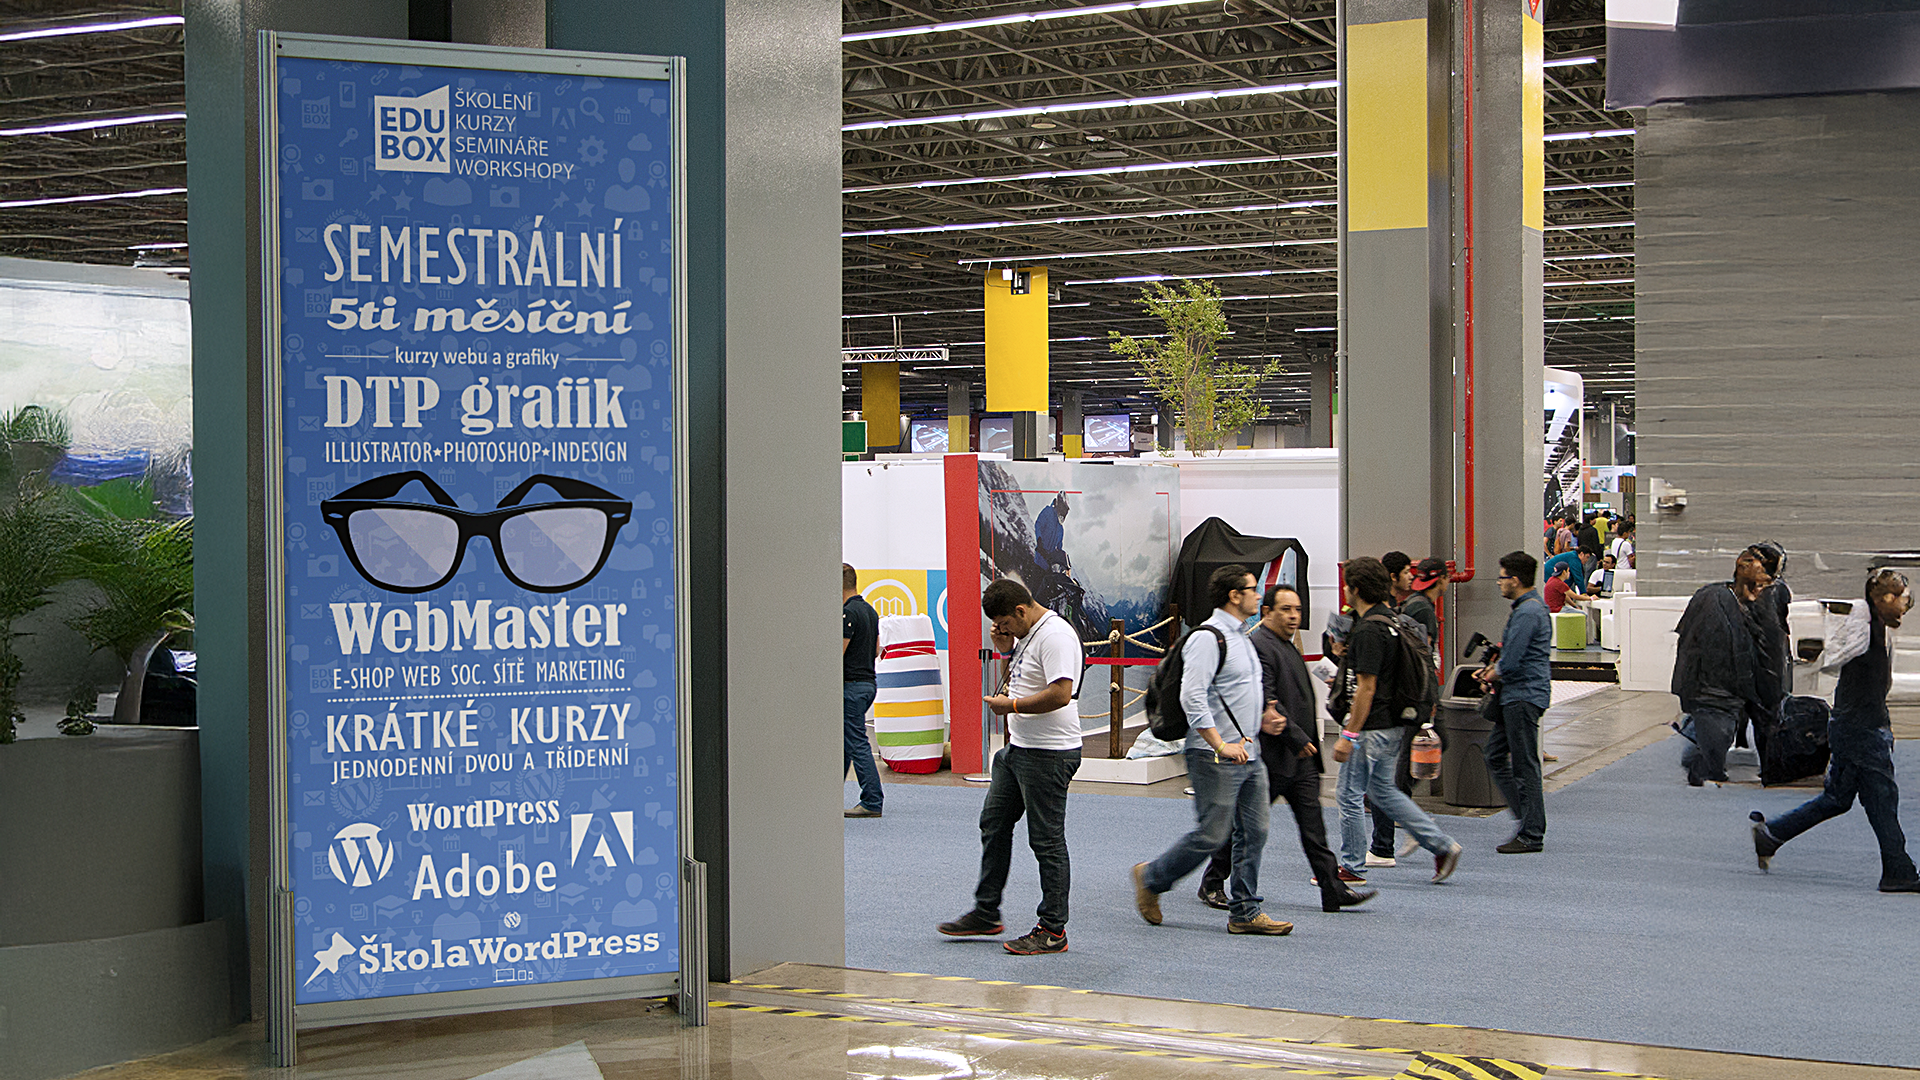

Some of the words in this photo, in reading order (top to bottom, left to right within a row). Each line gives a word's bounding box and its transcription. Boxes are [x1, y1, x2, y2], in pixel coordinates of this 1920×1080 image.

[304, 103, 329, 114] EDU
[455, 89, 532, 111] ŠKOLENÍ
[304, 113, 329, 125] BOX
[380, 106, 446, 134] EDU
[455, 113, 516, 132] KURZY
[380, 135, 447, 163] BOX
[455, 136, 549, 157] SEMINÁŘE
[455, 158, 574, 180] WORKSHOPY
[323, 215, 623, 288] SEMESTRÁLNÍ
[327, 296, 401, 331] 5ti
[413, 298, 632, 335] měsíční
[395, 346, 439, 368] kurzy
[442, 347, 488, 365] webu
[492, 352, 501, 365] a
[506, 348, 560, 370] grafiky
[323, 375, 440, 428] DTP
[460, 376, 628, 436] grafik
[325, 441, 433, 463] ILLUSTRATOR
[444, 441, 542, 463] PHOTOSHOP
[552, 441, 627, 462] INDESIGN
[329, 597, 628, 655] WebMaster
[333, 666, 395, 690] E-SHOP
[401, 665, 441, 688] WEB
[451, 663, 487, 686] SOC.
[493, 656, 525, 685] SÍTĚ
[536, 658, 625, 683] MARKETING
[326, 700, 479, 753] KRÁTKÉ
[511, 703, 632, 745] KURZY
[331, 750, 453, 785] JEDNODENNÍ
[465, 753, 513, 774] DVOU
[523, 752, 535, 771] A
[545, 745, 630, 769] TŘÍDENNÍ
[406, 799, 560, 832] WordPress
[411, 849, 557, 901] Adobe
[359, 930, 660, 976] ŠkolaWordPress
